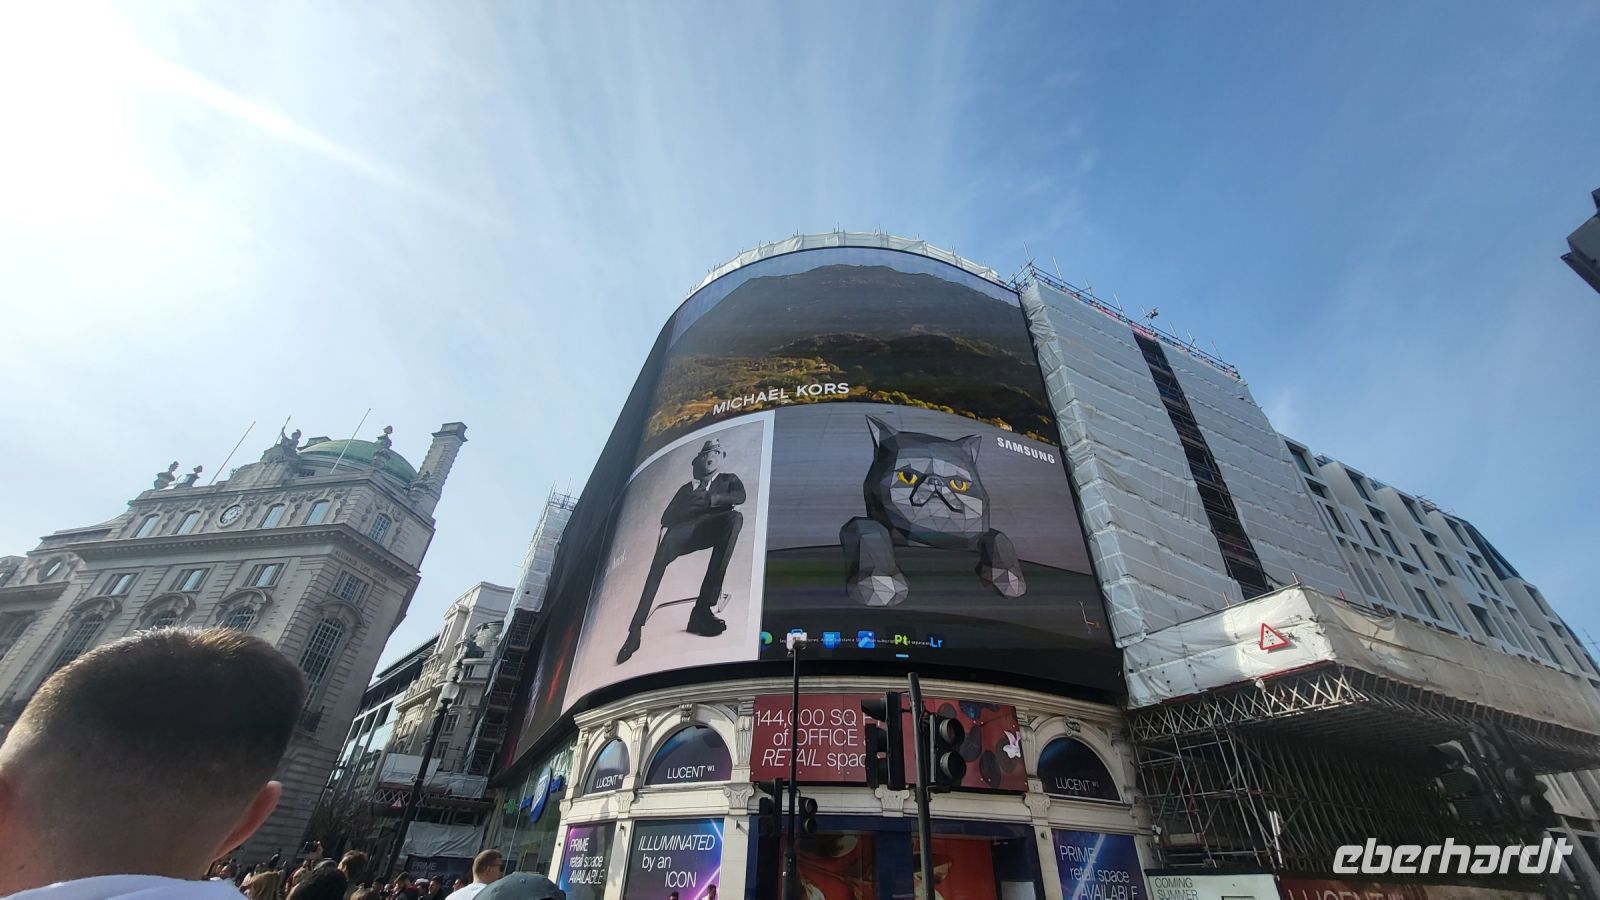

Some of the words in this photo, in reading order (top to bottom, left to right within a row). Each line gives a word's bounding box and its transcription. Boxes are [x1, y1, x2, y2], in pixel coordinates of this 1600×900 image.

[712, 388, 789, 415] MICHAEL
[796, 382, 849, 397] KORS
[996, 437, 1055, 464] SAMSUNG
[894, 634, 909, 646] Pt
[930, 636, 943, 648] Lr
[830, 708, 857, 726] SQ
[773, 728, 790, 746] of
[796, 728, 859, 746] OFFICE
[761, 748, 822, 767] RETAIL
[826, 752, 867, 771] spac
[667, 765, 706, 779] LUCENT
[595, 774, 619, 789] LUCENT
[1055, 777, 1091, 792] LUCENT
[570, 837, 590, 851] PRIME
[638, 834, 716, 851] ILLUMINATED
[642, 853, 656, 872] by
[657, 856, 672, 869] an
[1059, 845, 1097, 864] PRIME
[568, 869, 606, 884] AVAILABLE
[665, 871, 697, 888] ICON
[1070, 866, 1096, 882] retail
[1098, 869, 1130, 884] space
[1154, 877, 1193, 889] COMING
[1157, 889, 1198, 900] SUMMER
